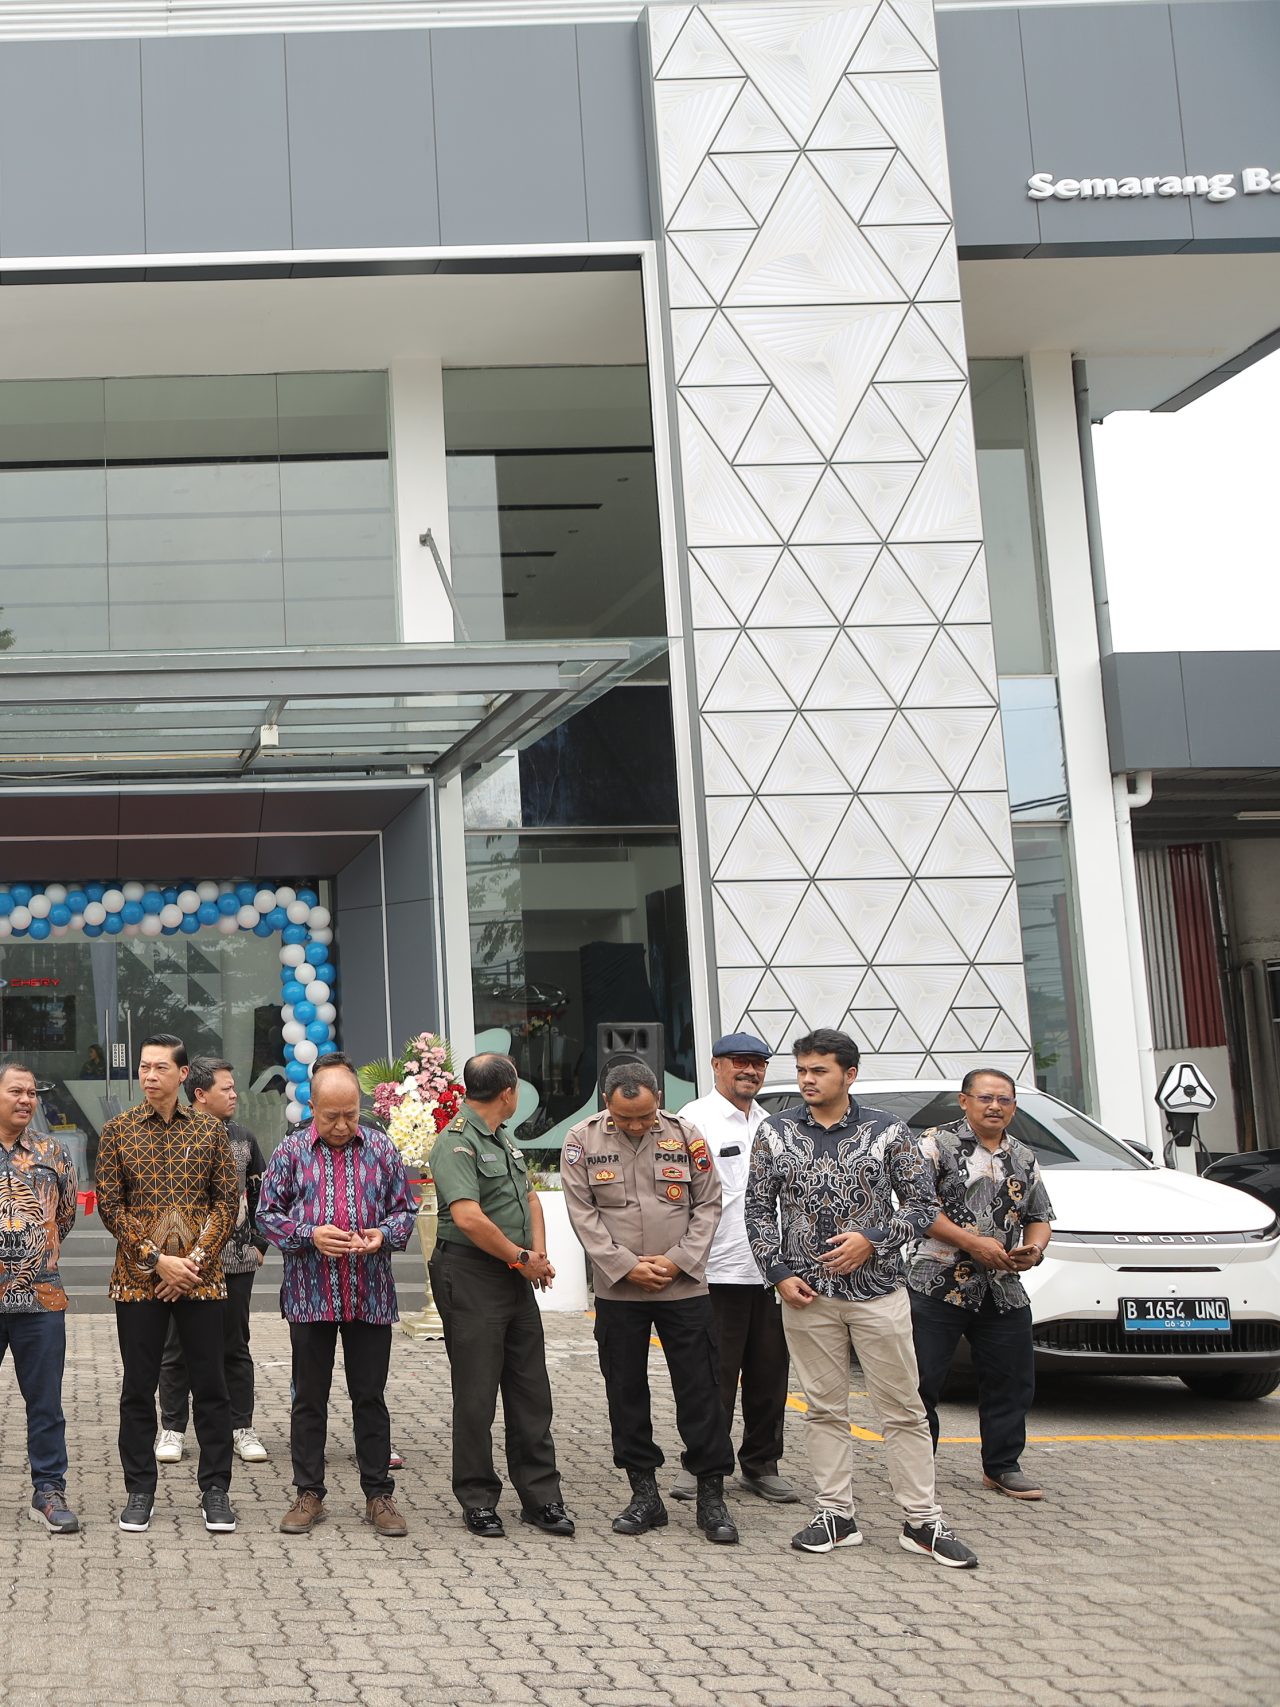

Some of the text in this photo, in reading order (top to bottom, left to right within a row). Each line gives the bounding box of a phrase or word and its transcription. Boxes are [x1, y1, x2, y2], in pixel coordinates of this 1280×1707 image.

[1028, 172, 1236, 202] Semarang
[10, 978, 61, 987] CHERY
[587, 1156, 607, 1165] FUAD
[655, 1153, 688, 1163] POLRI
[1114, 1235, 1218, 1243] OMODA
[1127, 1301, 1226, 1319] B 1654 UNQ
